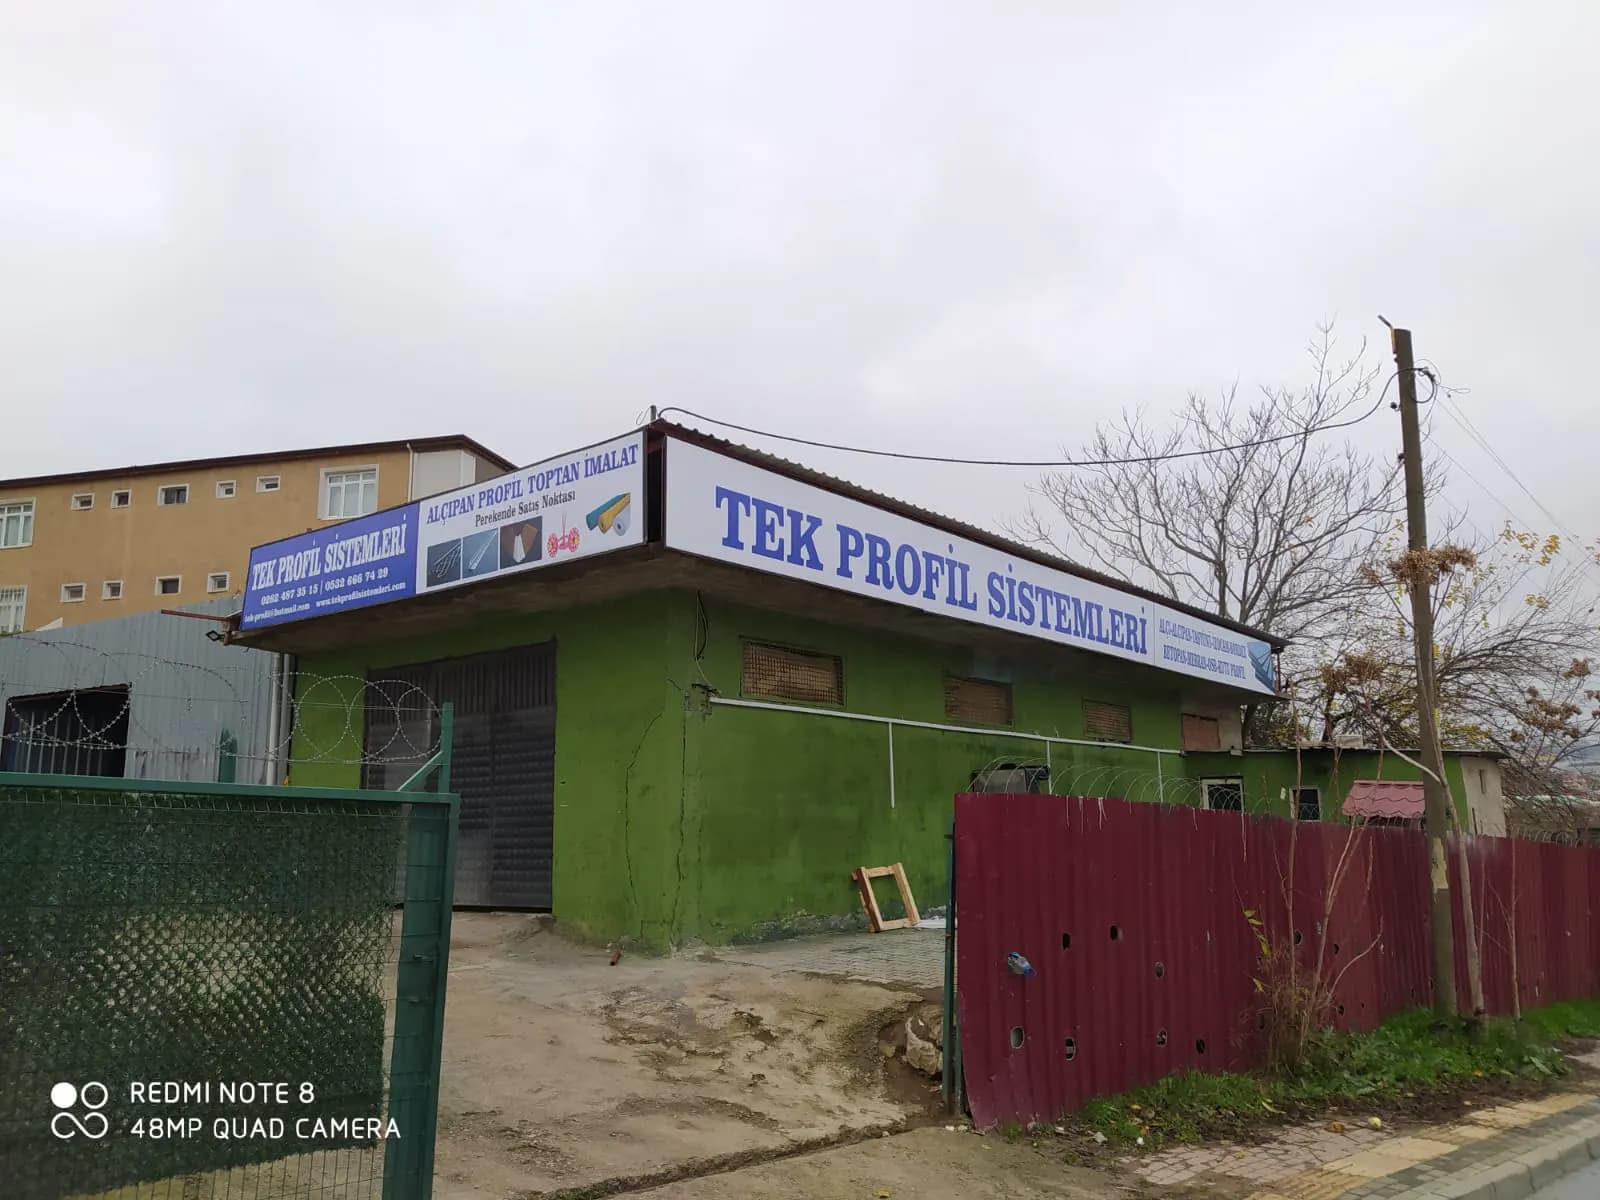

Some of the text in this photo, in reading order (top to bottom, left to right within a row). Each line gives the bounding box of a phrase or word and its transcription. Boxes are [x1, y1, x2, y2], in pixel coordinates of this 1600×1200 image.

[427, 444, 639, 525] ALÇIPAN PROFİL TOPTAN İMALAT
[475, 490, 576, 527] Perekende Satış Noktası
[252, 513, 407, 591] TEK PROFİL SİSTEMLERİ
[325, 577, 345, 592] 0532
[364, 570, 375, 583] 74
[715, 485, 1148, 656] TEK PROFİL SİSTEMLERİ
